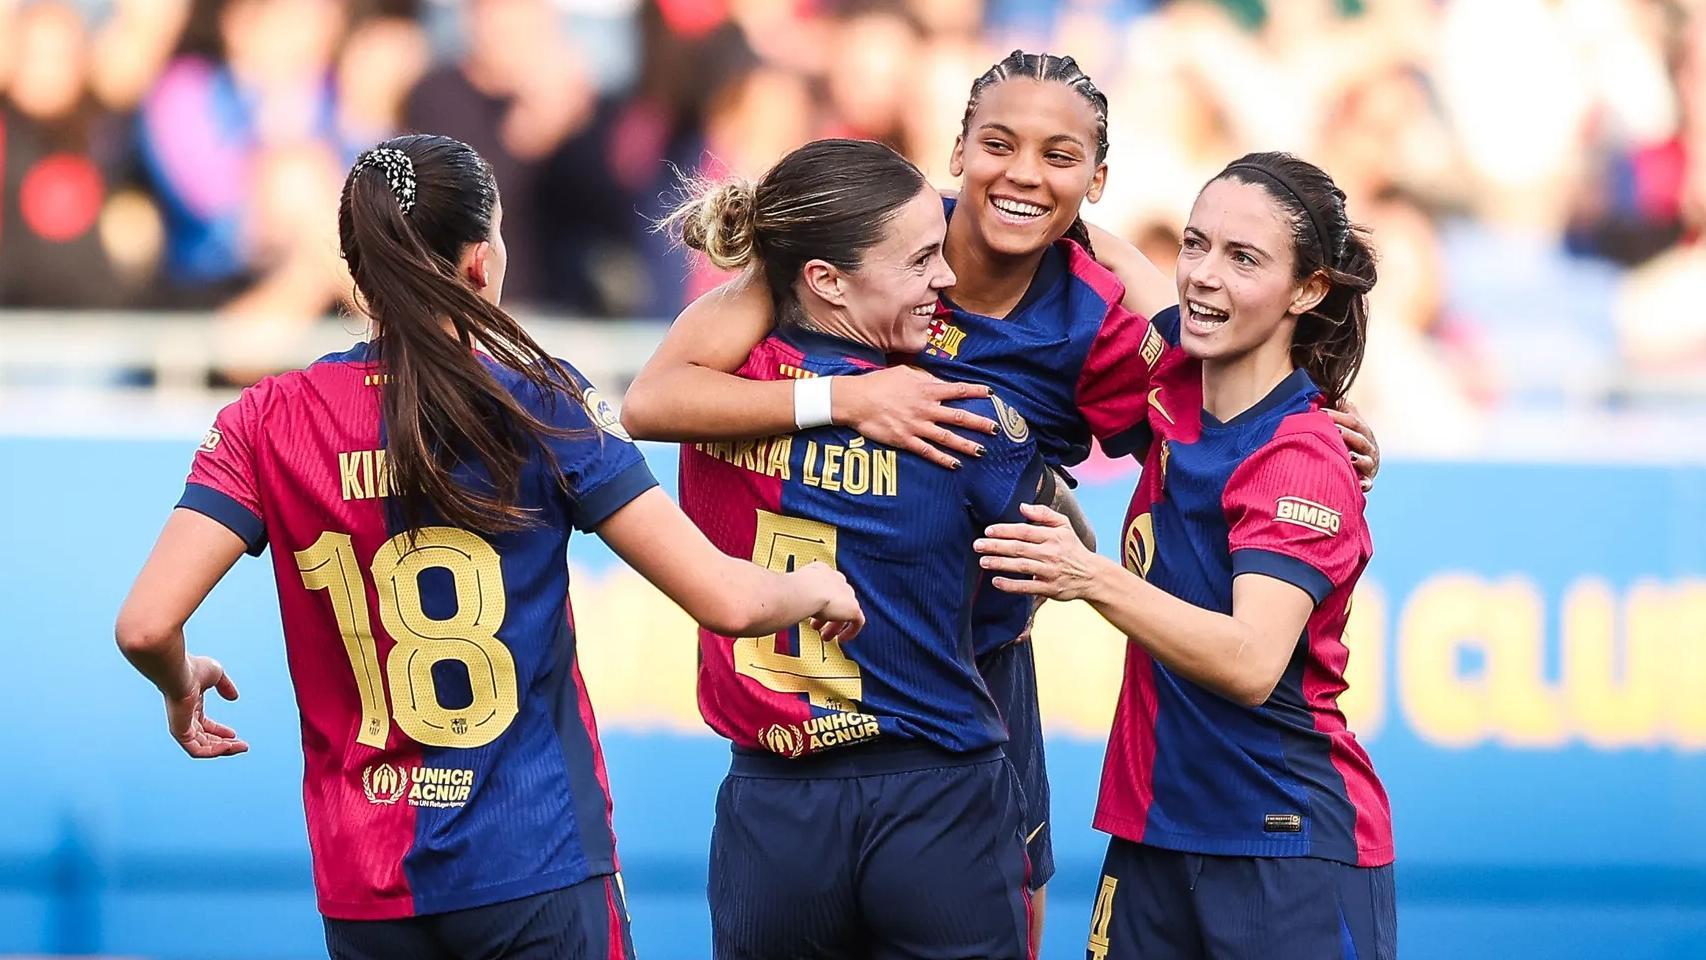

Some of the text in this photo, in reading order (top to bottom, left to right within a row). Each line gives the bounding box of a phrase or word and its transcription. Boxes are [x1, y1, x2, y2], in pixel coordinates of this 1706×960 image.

[803, 435, 897, 496] LEÓN
[1276, 501, 1340, 533] BIMBO
[733, 508, 863, 713] 4
[294, 526, 519, 750] 18
[809, 721, 880, 750] ACNUR
[411, 766, 474, 786] UNHCR
[408, 783, 471, 802] ACNUR
